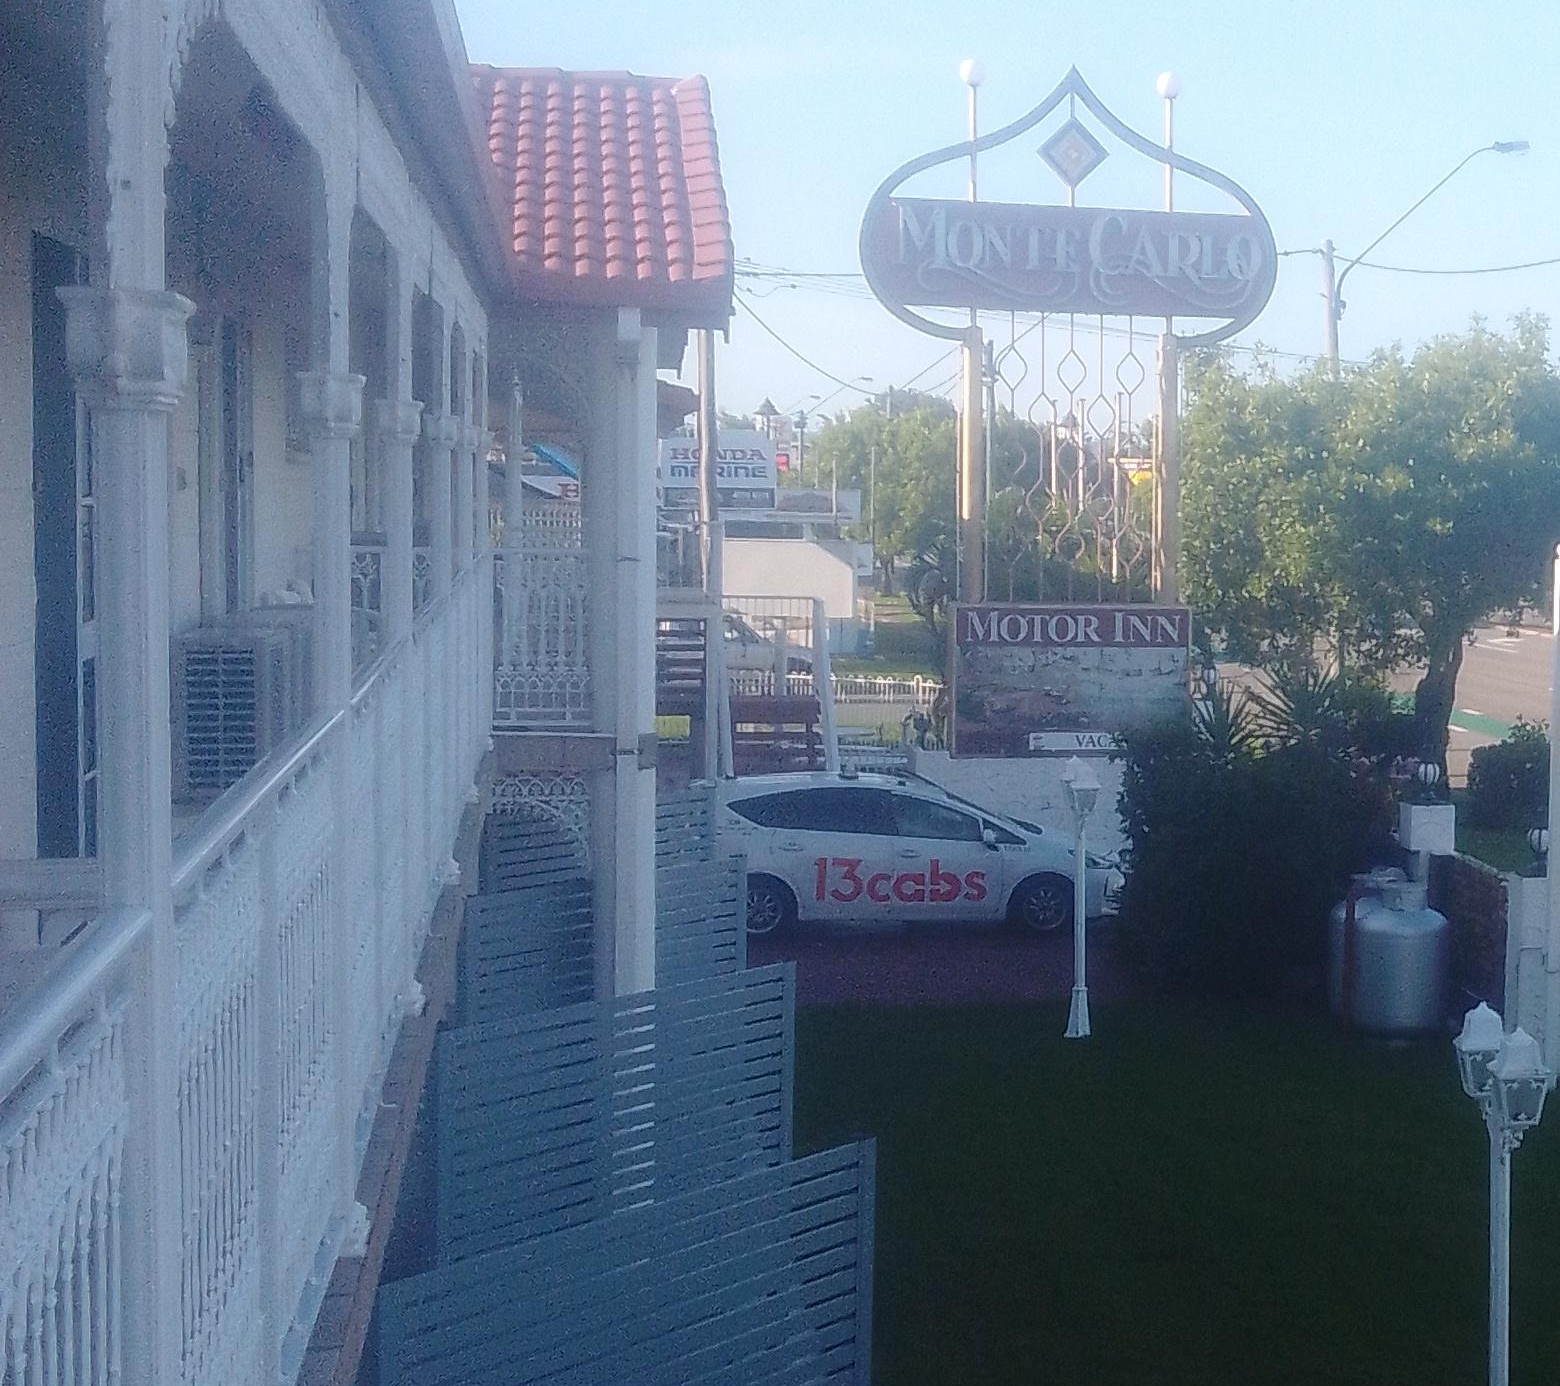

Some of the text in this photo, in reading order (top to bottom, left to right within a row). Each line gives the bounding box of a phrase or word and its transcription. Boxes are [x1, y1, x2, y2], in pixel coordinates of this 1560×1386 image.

[967, 611, 1181, 643] MOTOR INN
[813, 856, 988, 903] 13cabs
